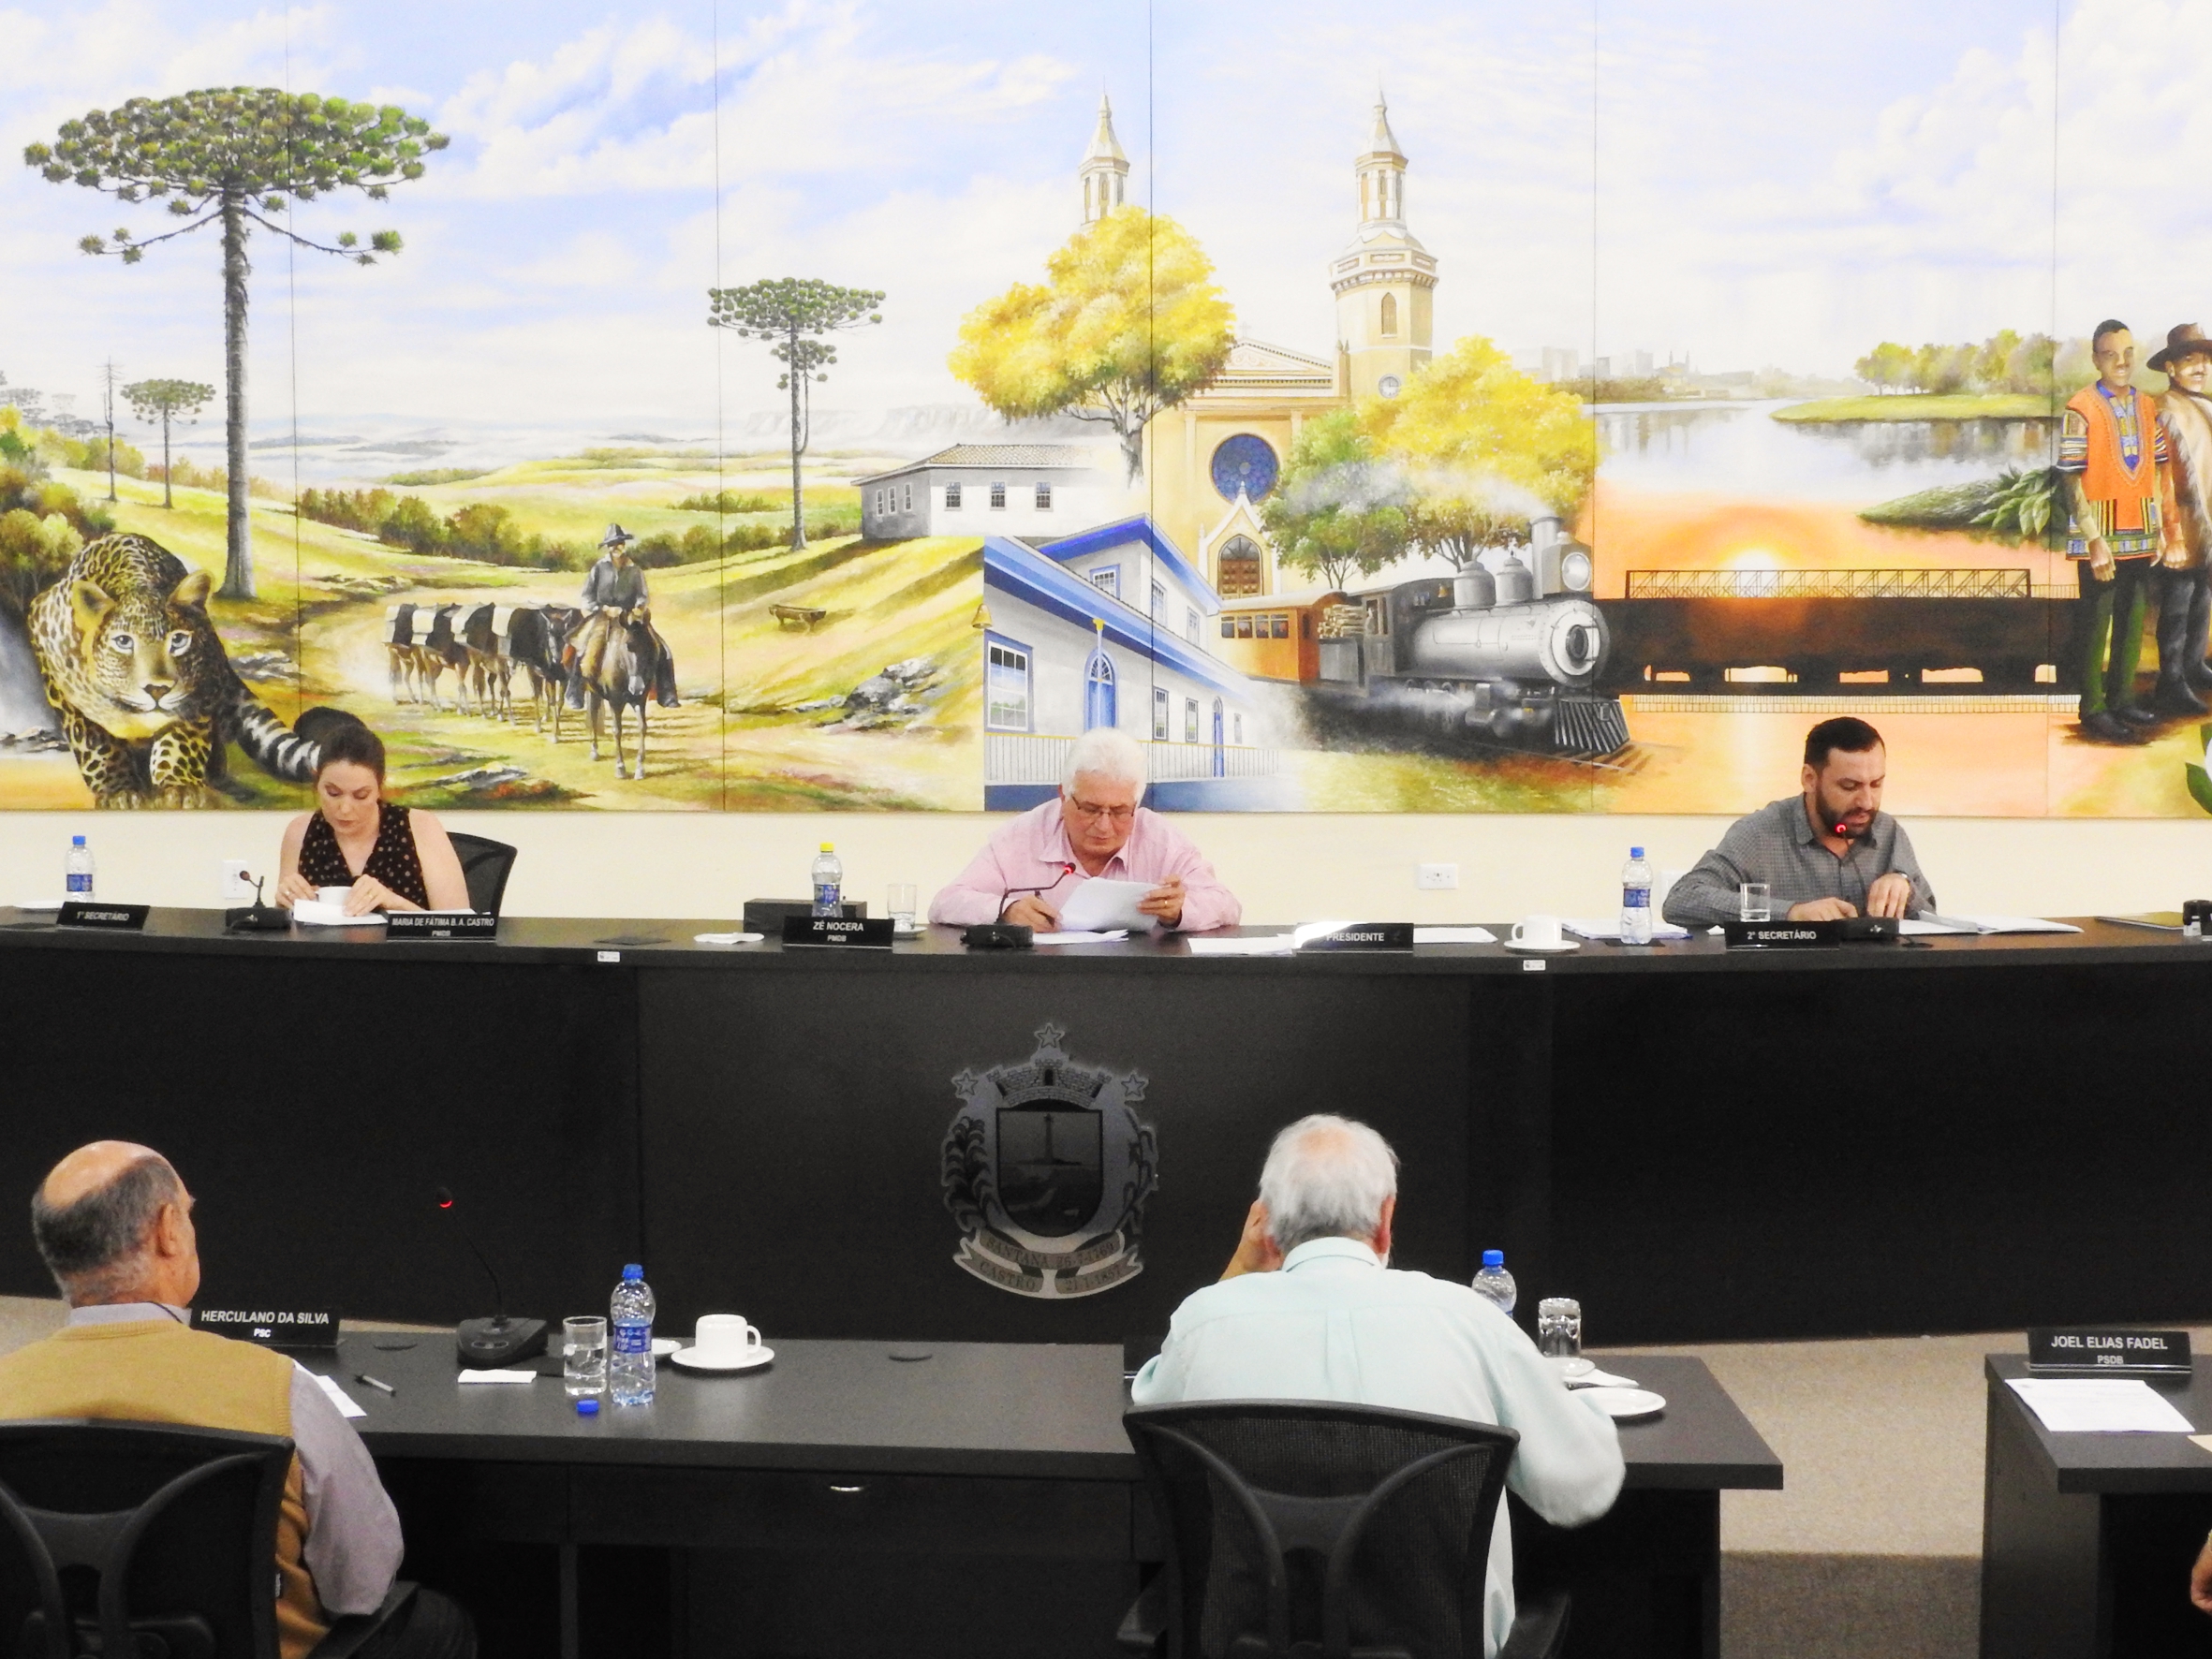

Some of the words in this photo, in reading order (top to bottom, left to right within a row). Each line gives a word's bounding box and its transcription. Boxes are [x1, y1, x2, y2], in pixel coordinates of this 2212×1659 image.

[391, 918, 413, 926] MARIA
[414, 918, 424, 926] DE
[425, 916, 450, 926] FÁTIMA
[466, 918, 494, 927] CASTRO
[812, 920, 825, 931] ZÉ
[826, 921, 864, 932] NOCERA
[1326, 932, 1385, 942] PRESIDENTE
[1758, 929, 1817, 940] SECRETÁRIO
[987, 1237, 1049, 1268] SANTANA
[980, 1260, 1036, 1290] CASTRO
[200, 1310, 275, 1324] HERCULANO
[277, 1312, 294, 1324] DA
[297, 1313, 330, 1325] SILVA
[254, 1328, 272, 1338] PSC
[2051, 1335, 2085, 1348] JOEL
[2087, 1336, 2124, 1349] ELIAS
[2127, 1337, 2168, 1350] FADEL
[2097, 1355, 2124, 1365] PSDB
